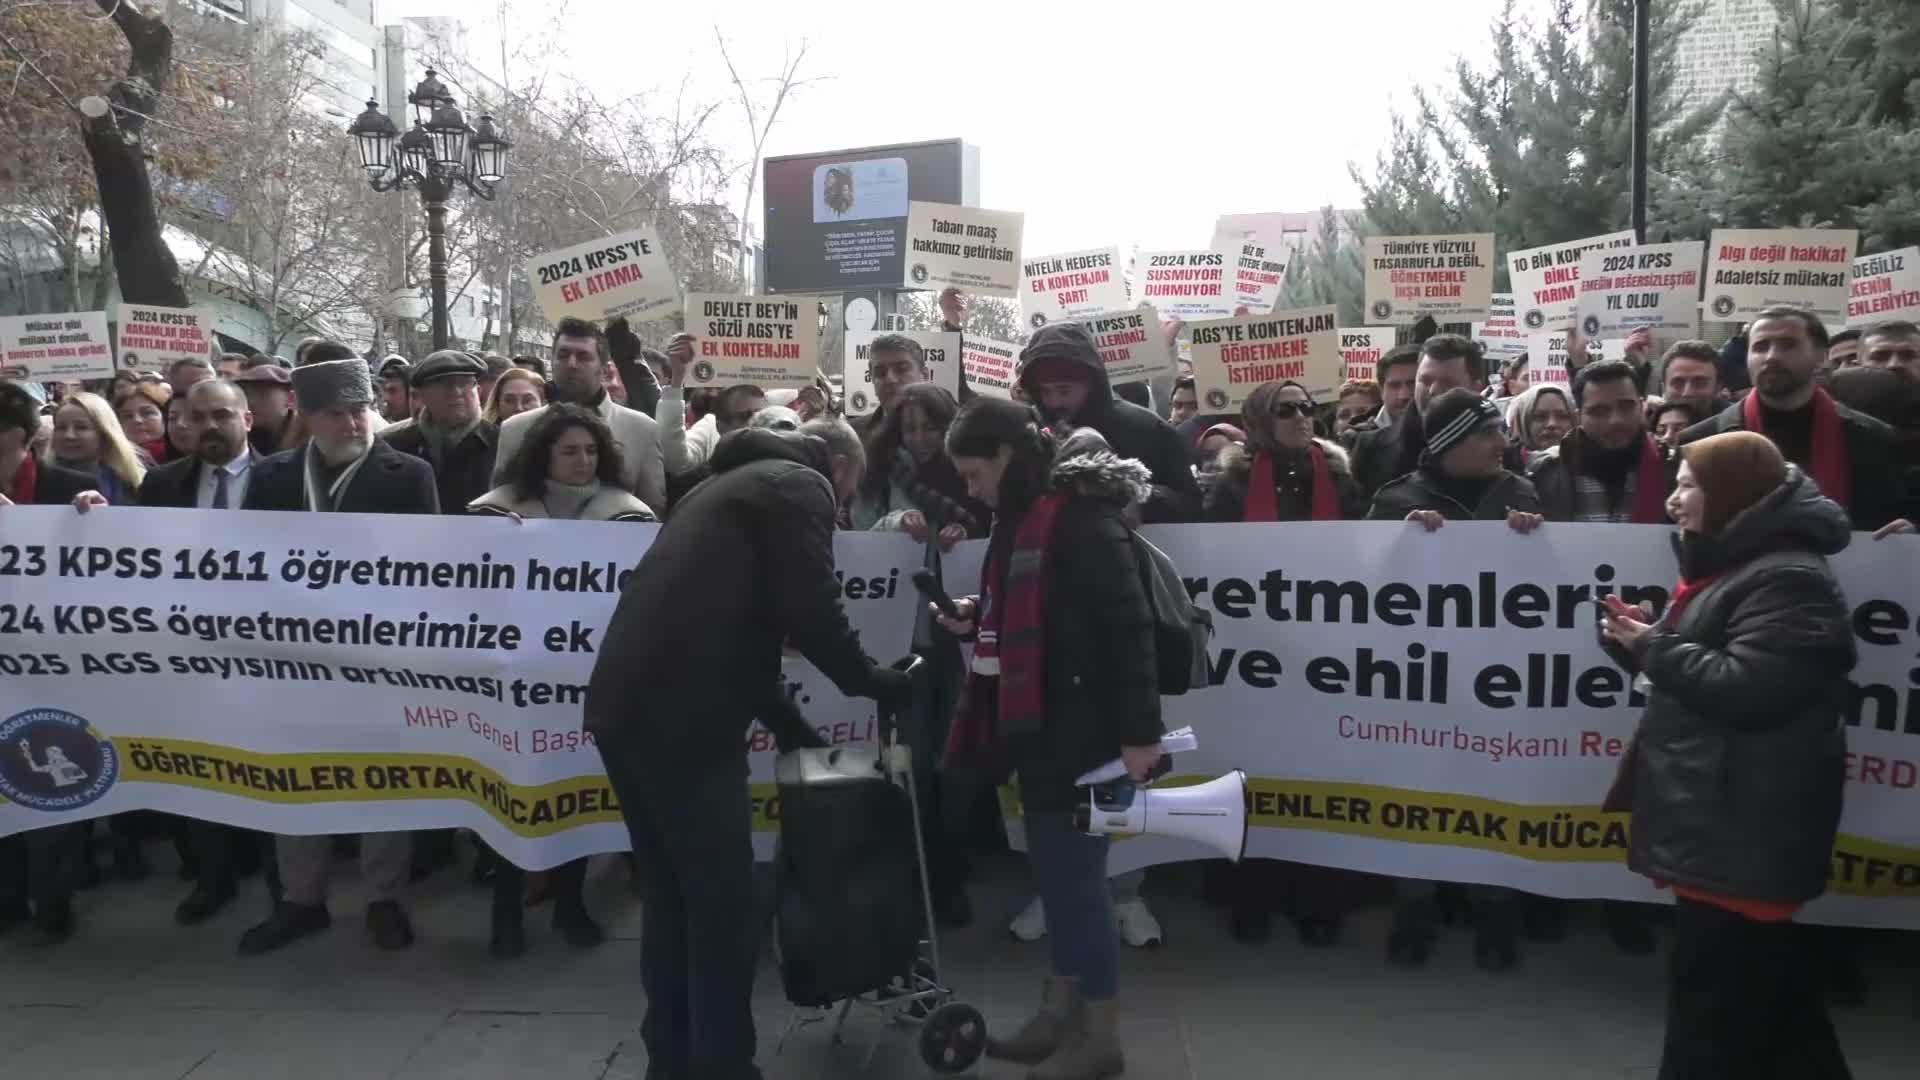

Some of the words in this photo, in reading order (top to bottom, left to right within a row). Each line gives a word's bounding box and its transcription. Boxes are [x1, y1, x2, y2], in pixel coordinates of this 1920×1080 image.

[932, 218, 963, 234] Taban
[966, 225, 997, 243] maaş
[913, 238, 961, 256] hakkımız
[963, 245, 1013, 262] getirilsin
[1383, 241, 1429, 255] TÜRKİYE
[1433, 240, 1475, 254] YÜZYILI
[1719, 245, 1745, 263] Algı
[1750, 245, 1785, 263] değil
[1790, 246, 1846, 263] hakikat
[537, 257, 582, 285] 2024
[586, 238, 651, 269] KPSS'YE
[1024, 257, 1064, 277] NİTELİK
[1066, 253, 1111, 272] HEDEFSE
[1150, 255, 1185, 267] 2024
[1189, 254, 1222, 266] KPSS
[1374, 257, 1444, 269] TASARRUFLA
[1513, 258, 1527, 272] 10
[1532, 252, 1551, 270] BİN
[1602, 254, 1634, 272] 2024
[1638, 252, 1672, 269] KPSS
[561, 283, 584, 303] EK
[586, 263, 643, 293] ATAMA
[1032, 279, 1045, 293] EK
[1047, 270, 1109, 291] KONTENJAN
[1146, 269, 1222, 281] SUSMUYOR!
[1390, 270, 1467, 284] ÖĞRETMENLE
[1544, 266, 1580, 285] BİNLE
[1715, 269, 1779, 285] Adaletsiz
[1783, 269, 1845, 287] mülakat
[1058, 290, 1088, 308] ŞART!
[1145, 284, 1221, 296] DURMUYOR!
[1425, 284, 1461, 297] EDİLİR
[1533, 285, 1576, 305] YARIM
[704, 301, 751, 318] DEVLET
[756, 299, 798, 320] BEY'İN
[1607, 294, 1622, 310] YIL
[1626, 293, 1659, 309] OLDU
[132, 310, 157, 322] 2024
[160, 313, 198, 326] KPSS'DE
[1096, 315, 1144, 333] KPSS'DE
[708, 320, 742, 338] SÖZÜ
[747, 322, 793, 339] AGS'YE
[1193, 325, 1243, 344] AGS'YE
[1248, 313, 1334, 340] KONTENJAN
[121, 337, 167, 350] HAYATLAR
[702, 341, 719, 356] EK
[723, 341, 800, 359] KONTENJAN
[1342, 334, 1370, 347] KPSS
[1549, 338, 1567, 350] 202
[1220, 339, 1308, 363] ÖĞRETMENE
[1228, 362, 1304, 384] İSTİHDAM!
[1544, 370, 1569, 382] ATAM
[0, 545, 47, 577] 23
[59, 546, 162, 579] KPSS
[173, 548, 269, 581] 1611
[281, 549, 515, 590] öğretmenin
[0, 604, 44, 634] 24
[54, 605, 159, 634] KPSS
[544, 621, 595, 653] ek
[0, 653, 70, 676] 025
[82, 652, 161, 675] AGS
[168, 655, 333, 681] sayısının
[340, 664, 503, 702] artılması
[1206, 648, 1282, 688] ve
[1305, 642, 1448, 704] ehil
[404, 705, 459, 729] MHP
[467, 712, 520, 754] Genel
[532, 729, 595, 753] Başk
[1338, 715, 1567, 762] Cumhurbaşkanı
[130, 743, 357, 793] ÖĞRETMENLER
[364, 766, 477, 794] ORTAK
[480, 777, 620, 826] MÜCADEL
[1381, 802, 1508, 842] ORTAK
